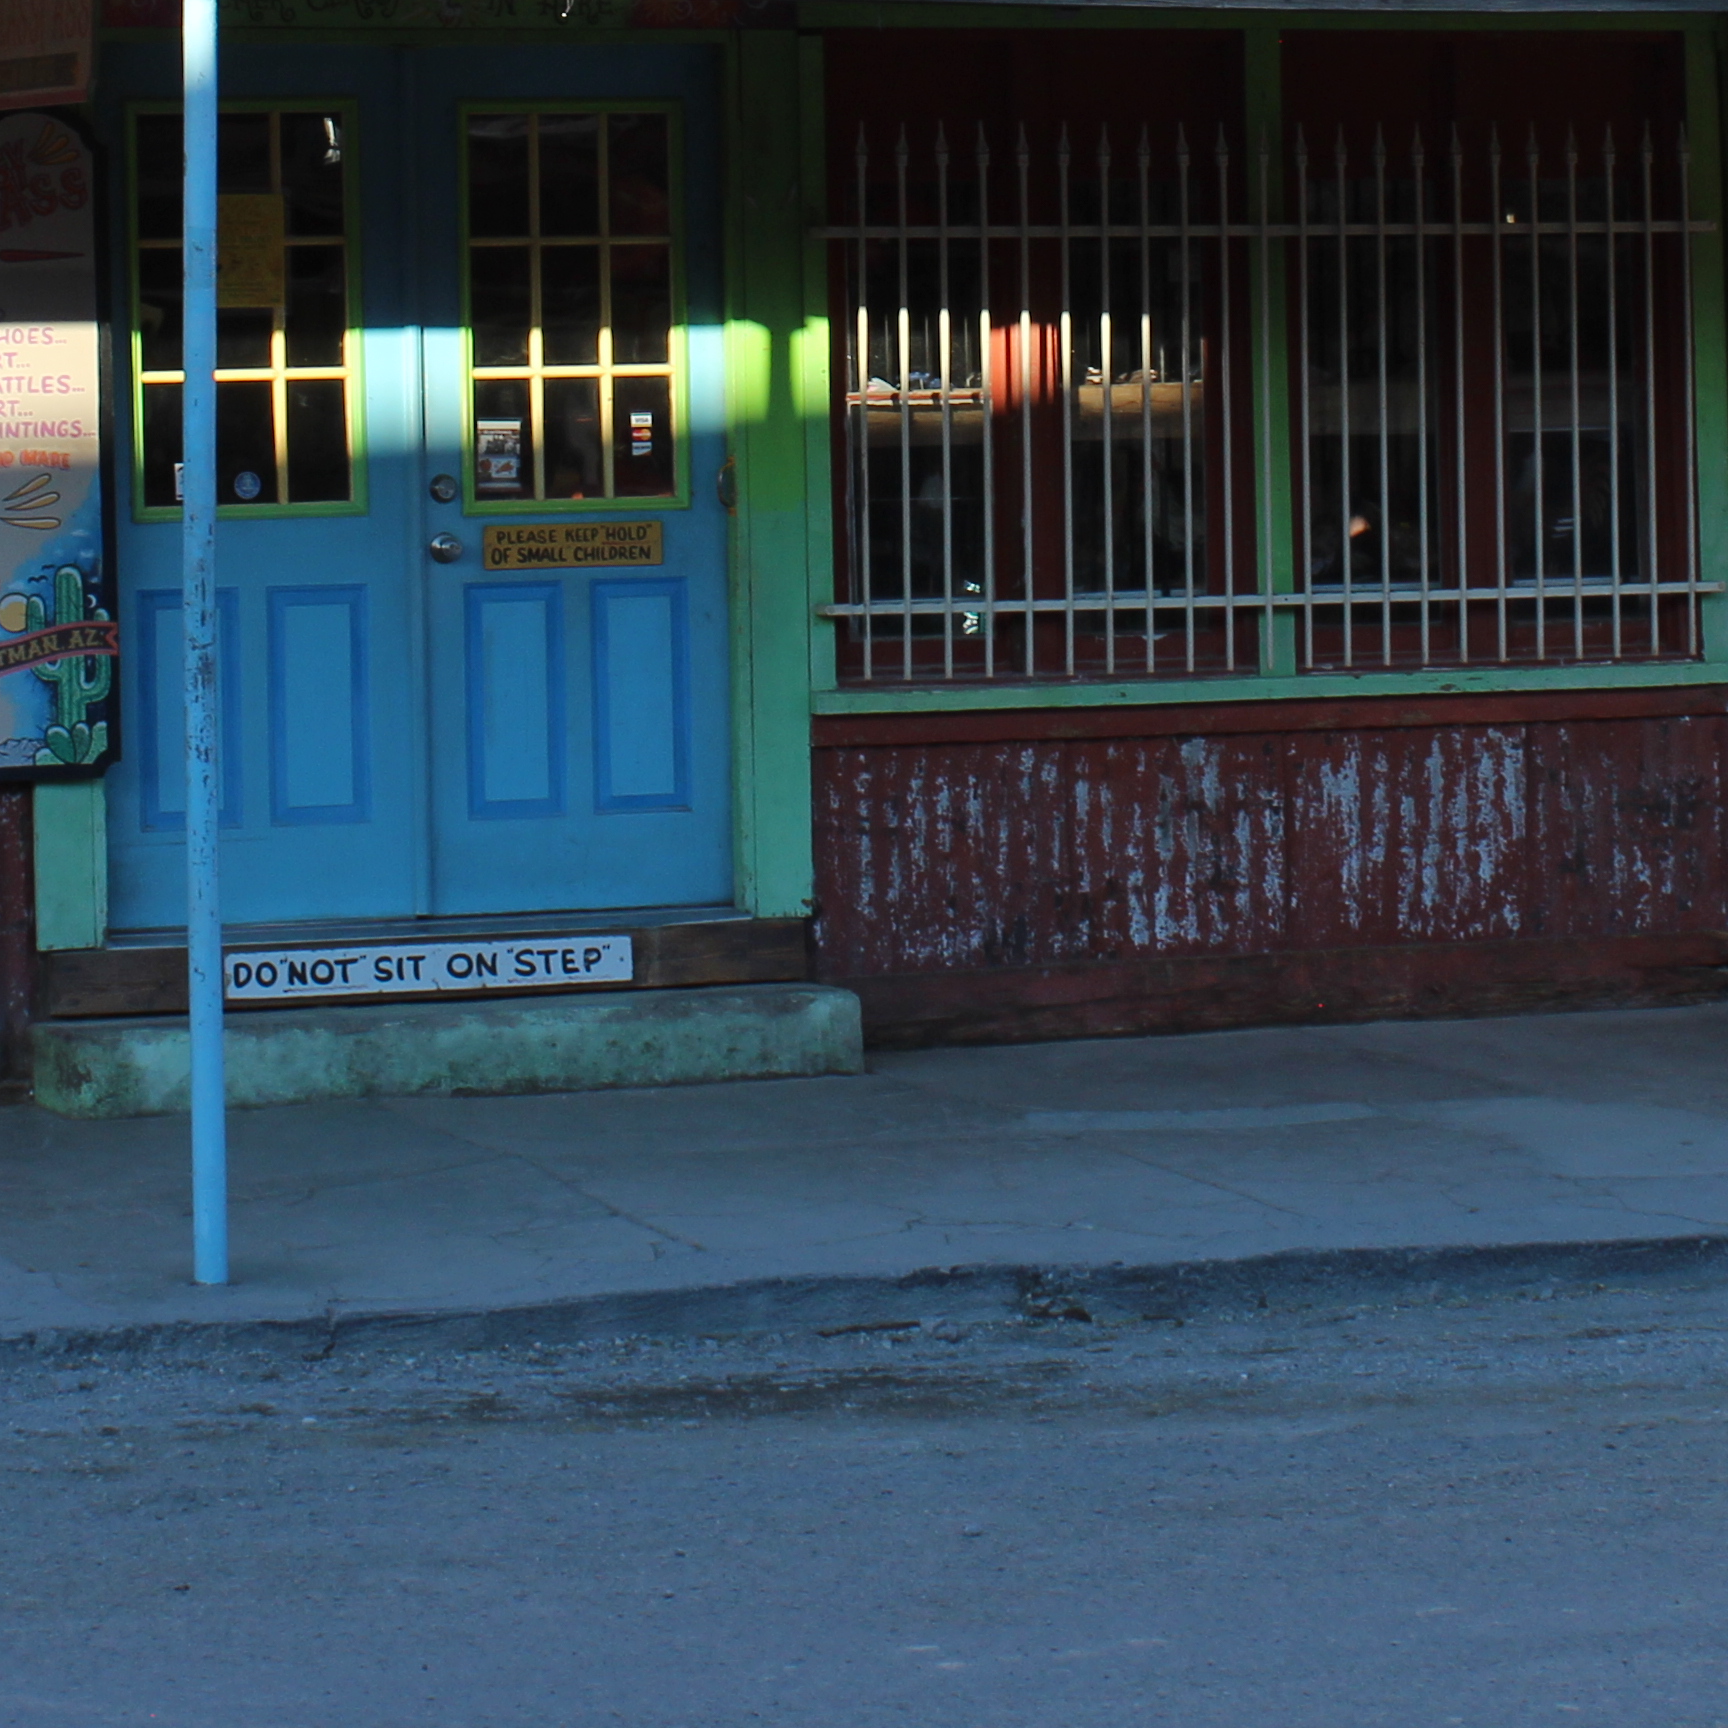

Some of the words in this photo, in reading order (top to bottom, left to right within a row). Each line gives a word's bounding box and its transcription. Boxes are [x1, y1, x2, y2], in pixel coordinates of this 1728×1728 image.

[19, 449, 71, 470] MADE
[496, 529, 556, 545] PLEASE
[565, 527, 599, 542] KEEP
[573, 545, 651, 562] CHILDREN
[232, 961, 278, 988] DO
[372, 956, 426, 982] SIT
[446, 952, 498, 979] ON
